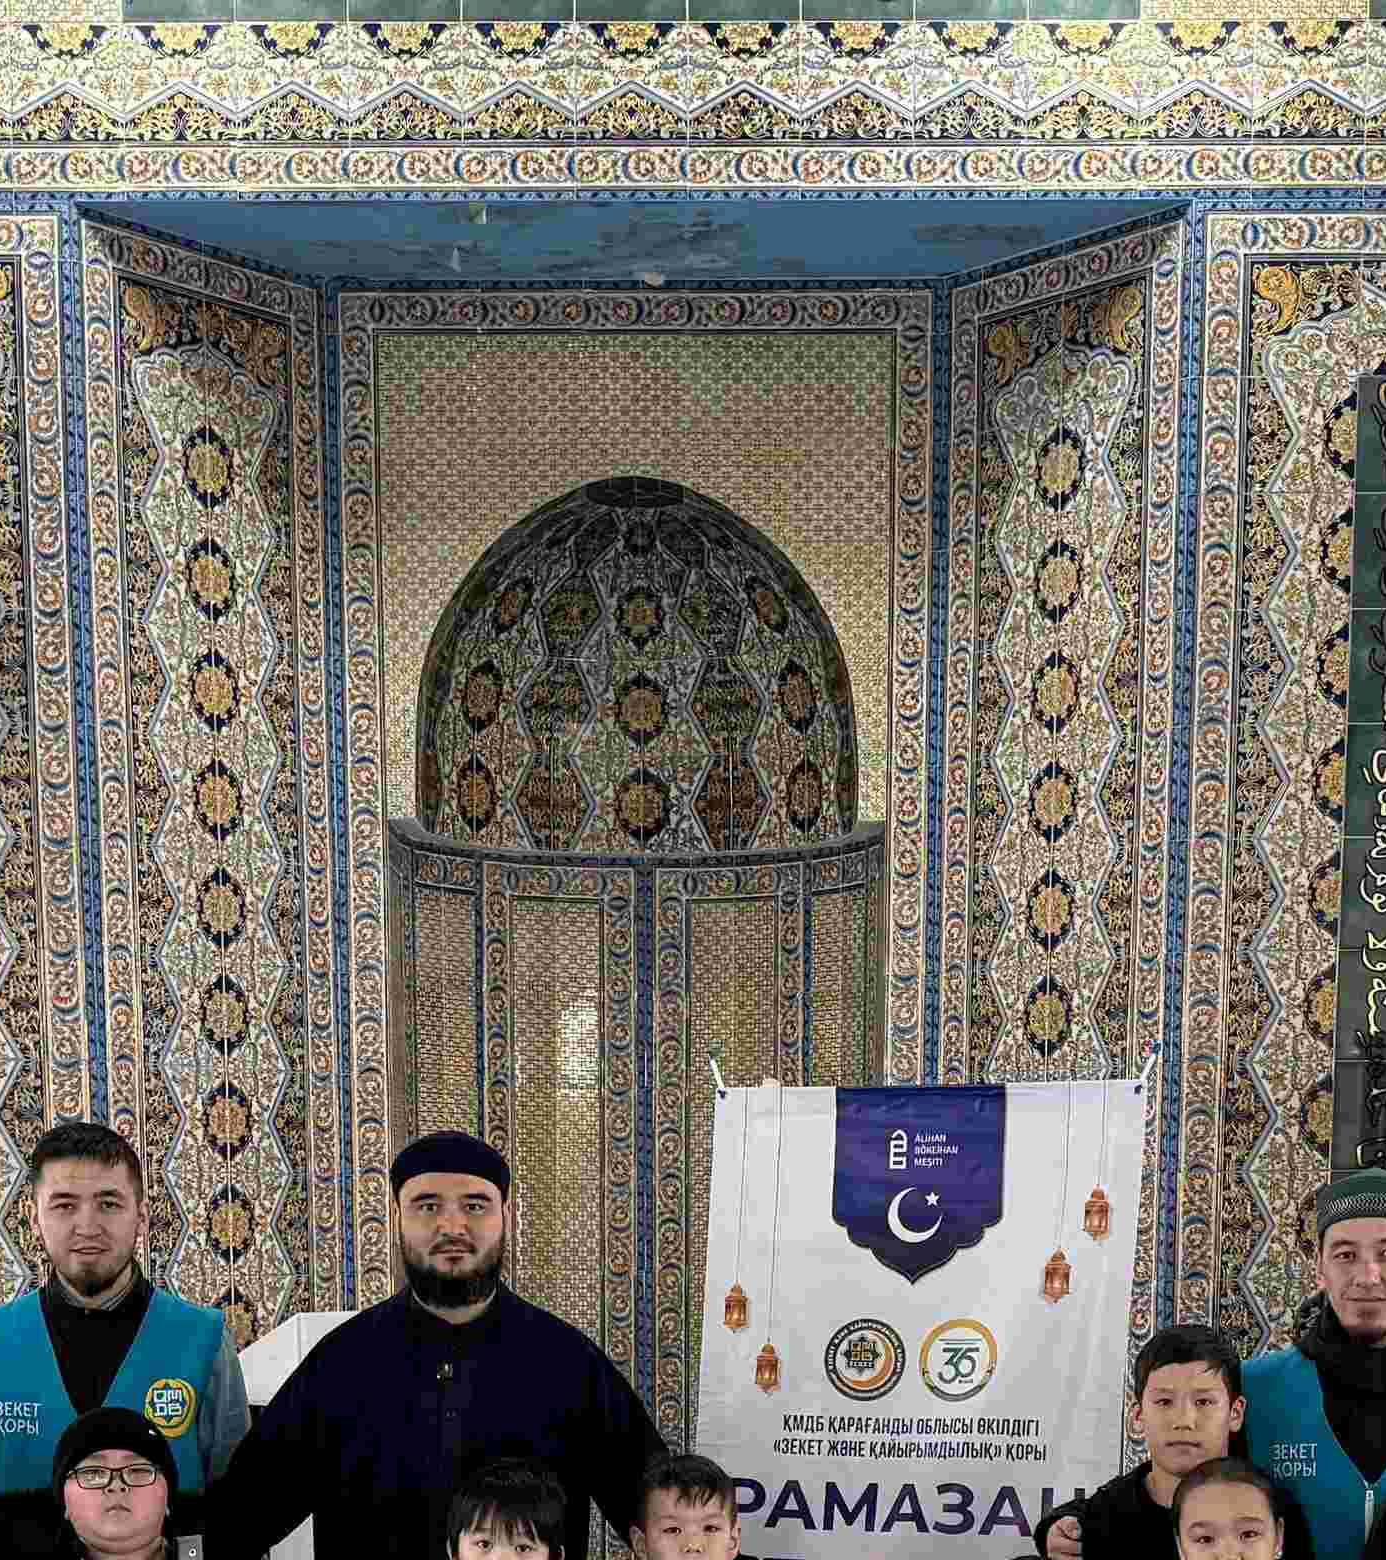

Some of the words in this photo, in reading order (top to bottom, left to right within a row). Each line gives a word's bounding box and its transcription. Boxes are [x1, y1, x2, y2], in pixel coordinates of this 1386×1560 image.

[782, 1414, 824, 1433] ҚМДБ
[827, 1416, 913, 1436] ҚАРАҒАНДЫ
[916, 1418, 974, 1434] ОБЛЫСЫ
[977, 1418, 1040, 1437] ӨКІЛДІГІ
[773, 1439, 823, 1456] «ЗЕКЕТ
[827, 1440, 867, 1457] ЖӘНЕ
[869, 1439, 1001, 1462] ҚАЙЫРЫМДЫЛЫҚ»
[1005, 1443, 1047, 1462] ҚОРЫ
[1271, 1442, 1318, 1460] ЗЕКЕТ
